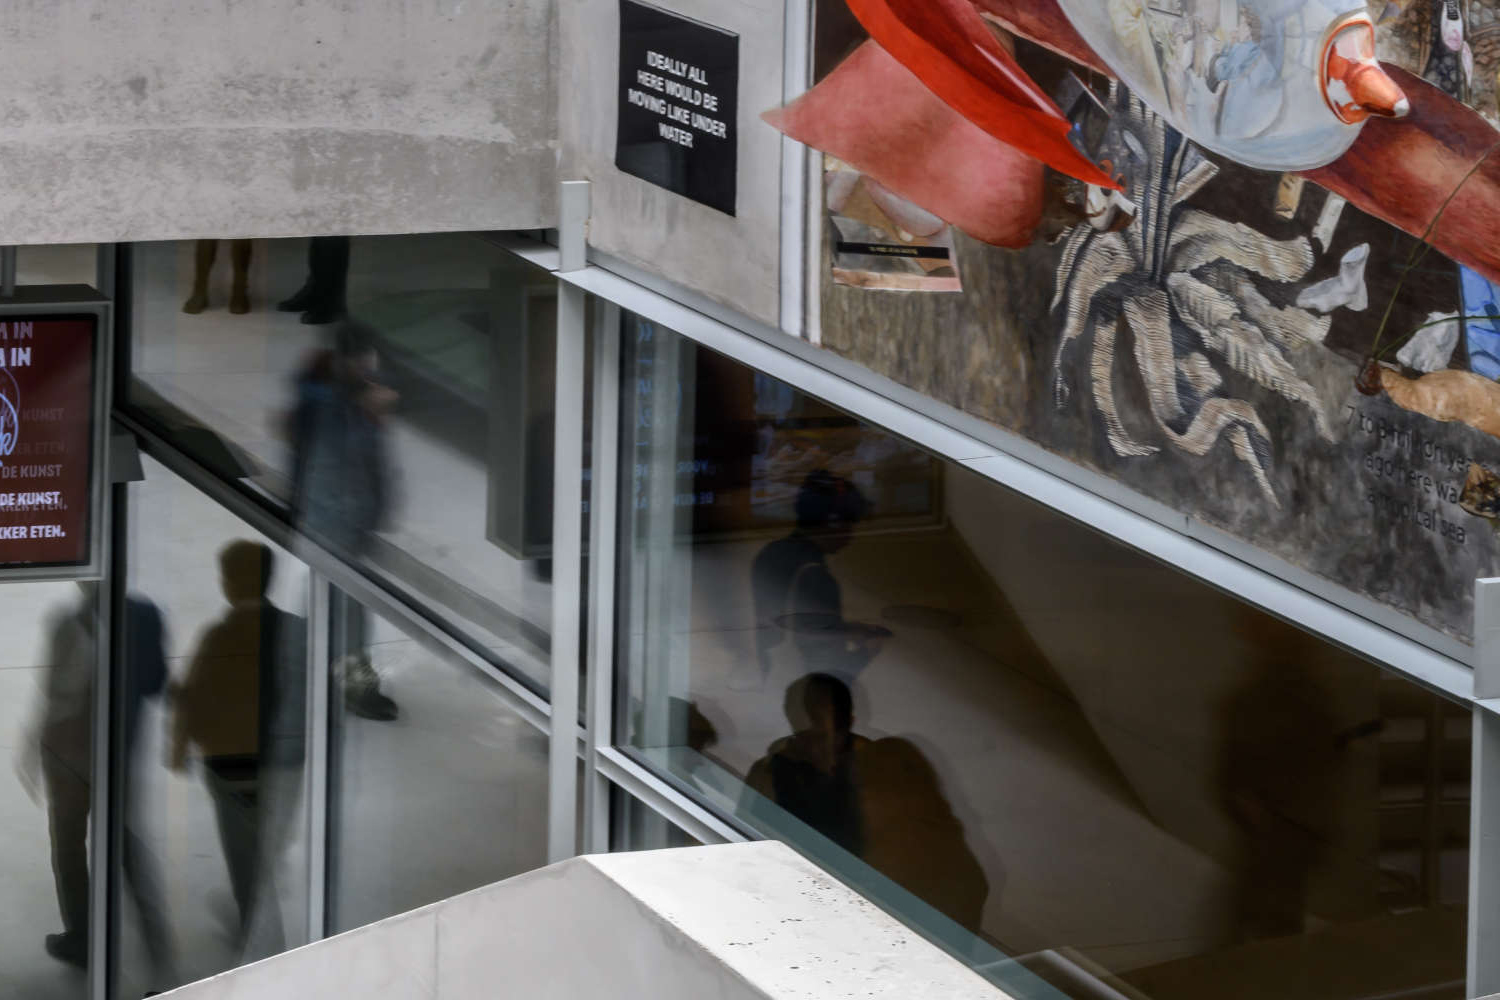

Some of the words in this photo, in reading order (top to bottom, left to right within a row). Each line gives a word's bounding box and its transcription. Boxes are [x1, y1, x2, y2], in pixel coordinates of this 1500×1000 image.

[647, 50, 688, 77] IDEALLY
[688, 66, 708, 85] ALL
[637, 70, 664, 92] HERE
[665, 80, 702, 106] WOULD
[703, 93, 718, 112] BE
[628, 88, 667, 115] MOVING
[667, 104, 690, 125] LIKE
[691, 112, 727, 139] UNDER
[659, 122, 694, 148] WATER
[11, 347, 32, 367] IN
[0, 493, 15, 506] DE
[17, 492, 60, 506] KUNST
[30, 525, 66, 539] ETEN.
[1440, 519, 1466, 544] sea
